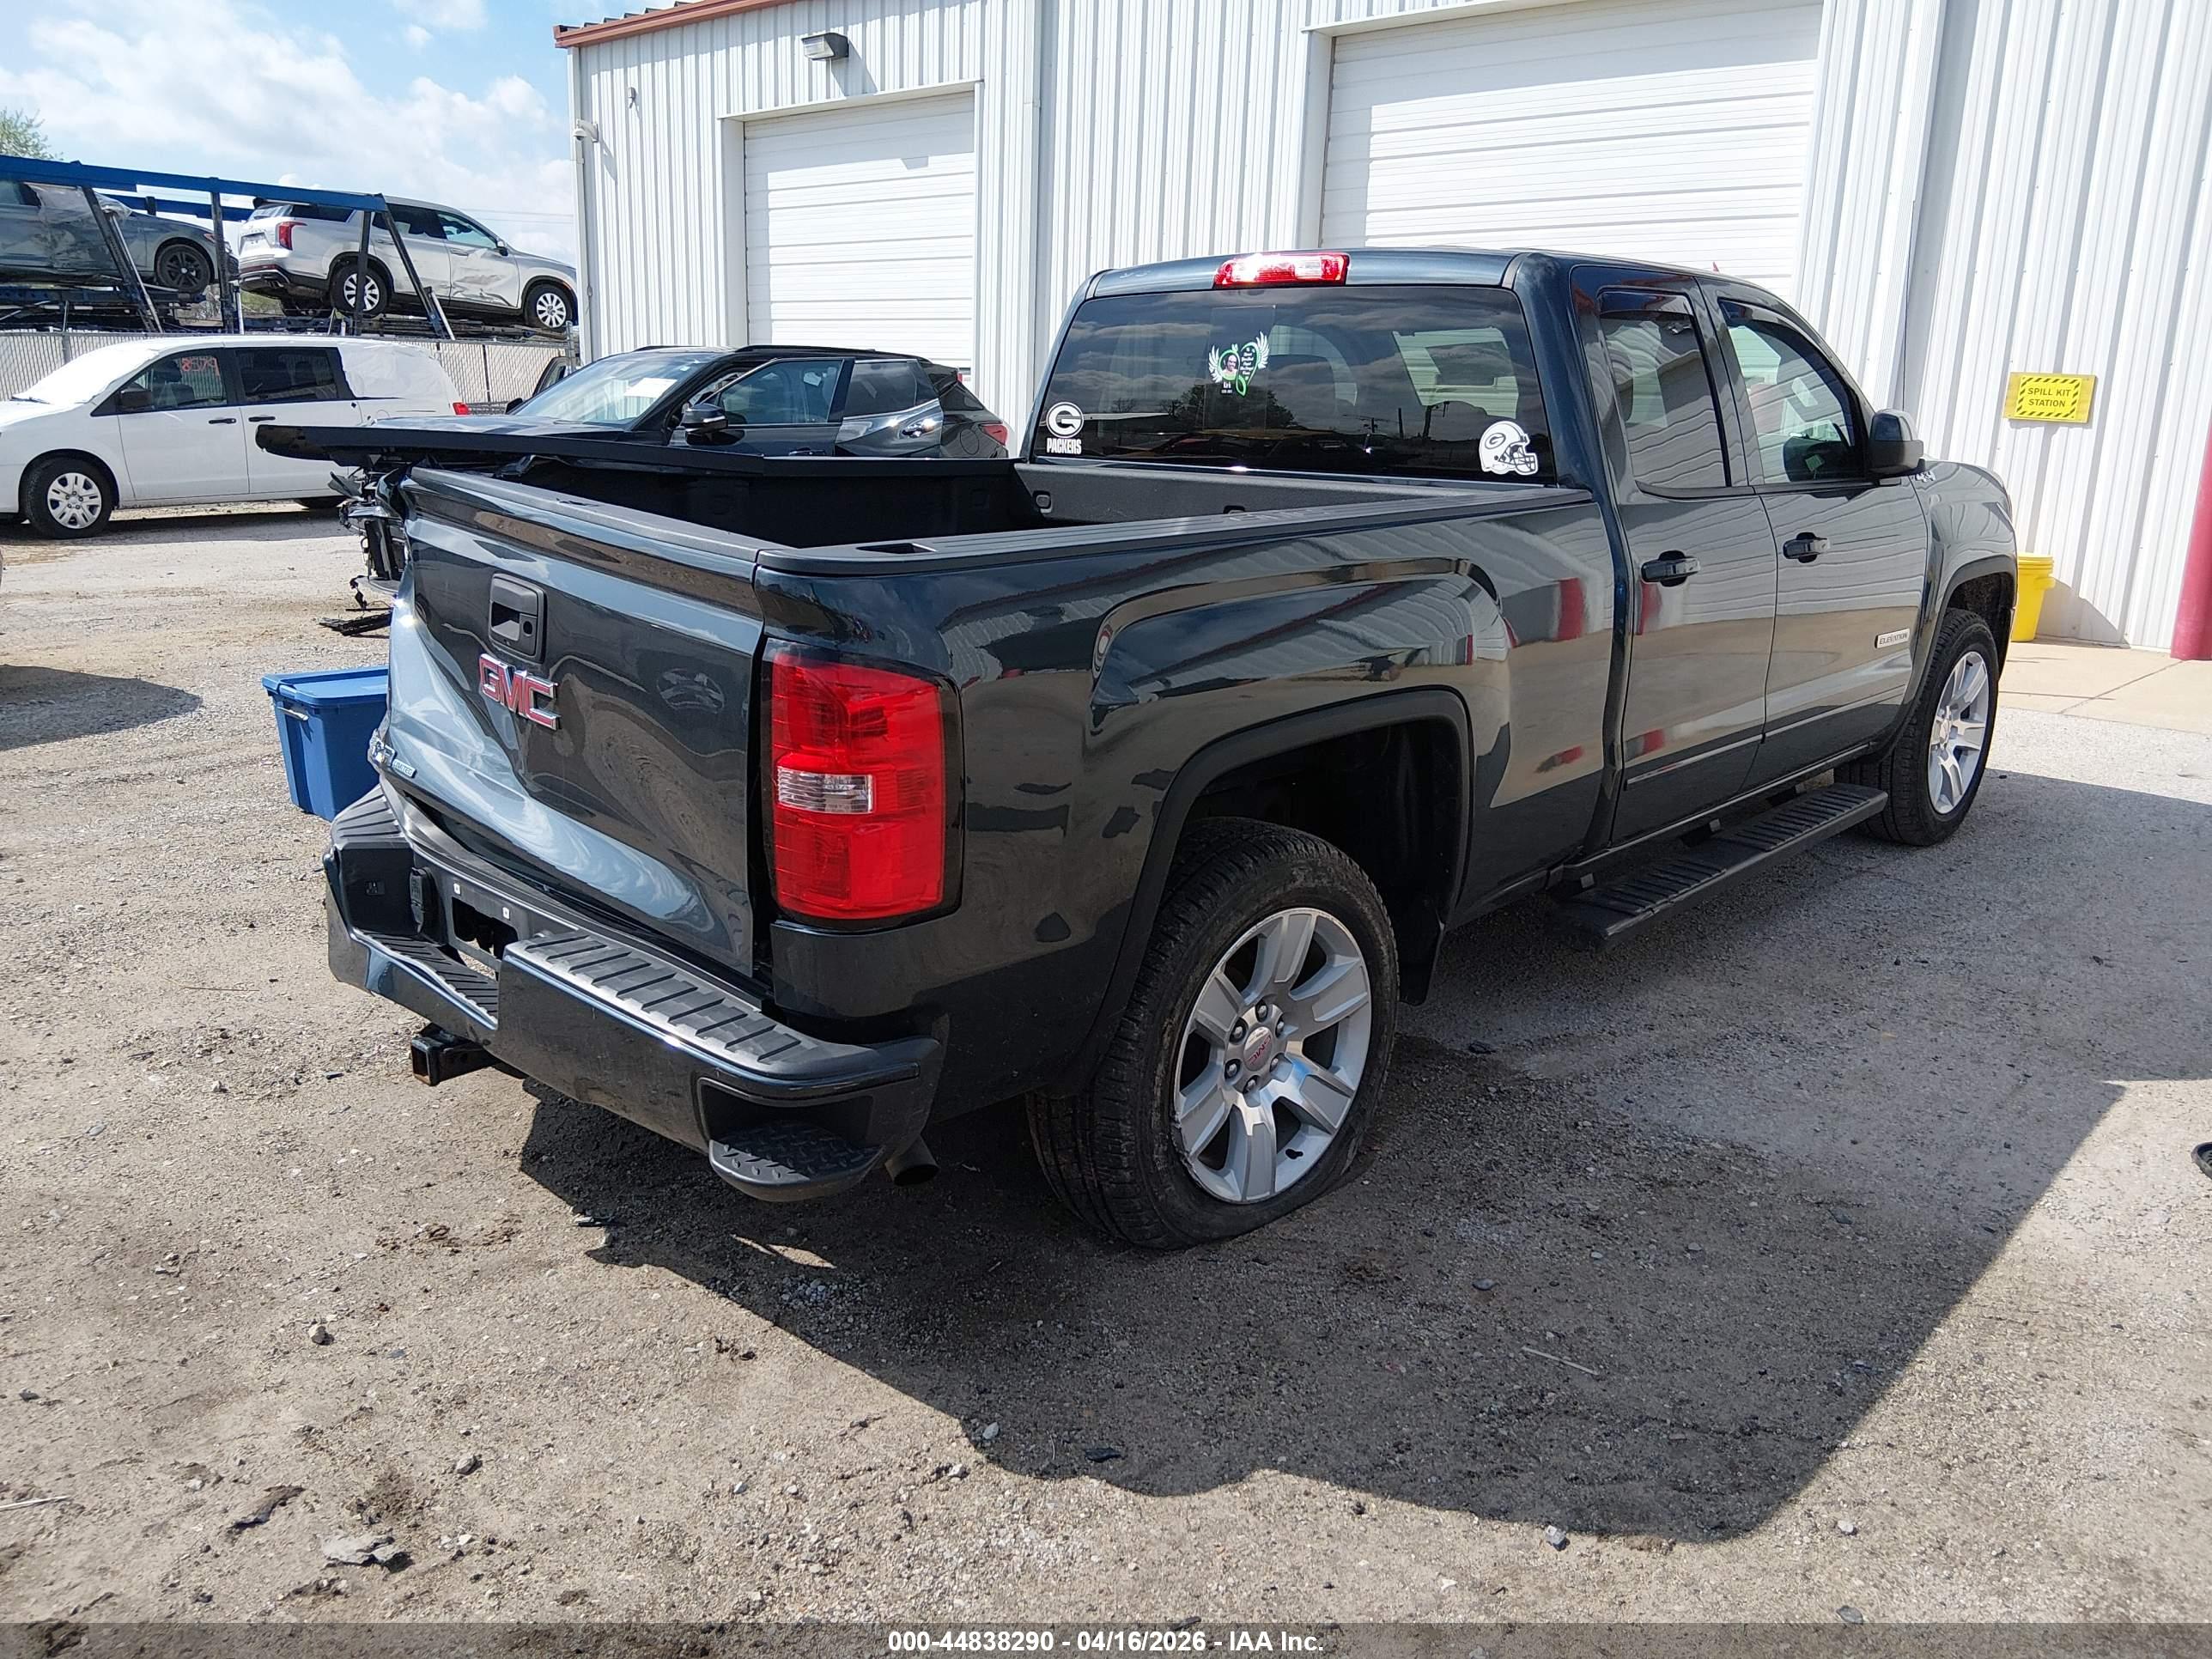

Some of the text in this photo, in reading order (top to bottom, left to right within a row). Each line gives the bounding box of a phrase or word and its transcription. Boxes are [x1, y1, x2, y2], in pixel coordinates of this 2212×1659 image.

[2027, 387, 2053, 396] SPILL
[2028, 398, 2066, 407] STATION
[1046, 437, 1082, 455] PACKERS
[479, 653, 562, 731] GMC
[1248, 1033, 1272, 1066] GMC
